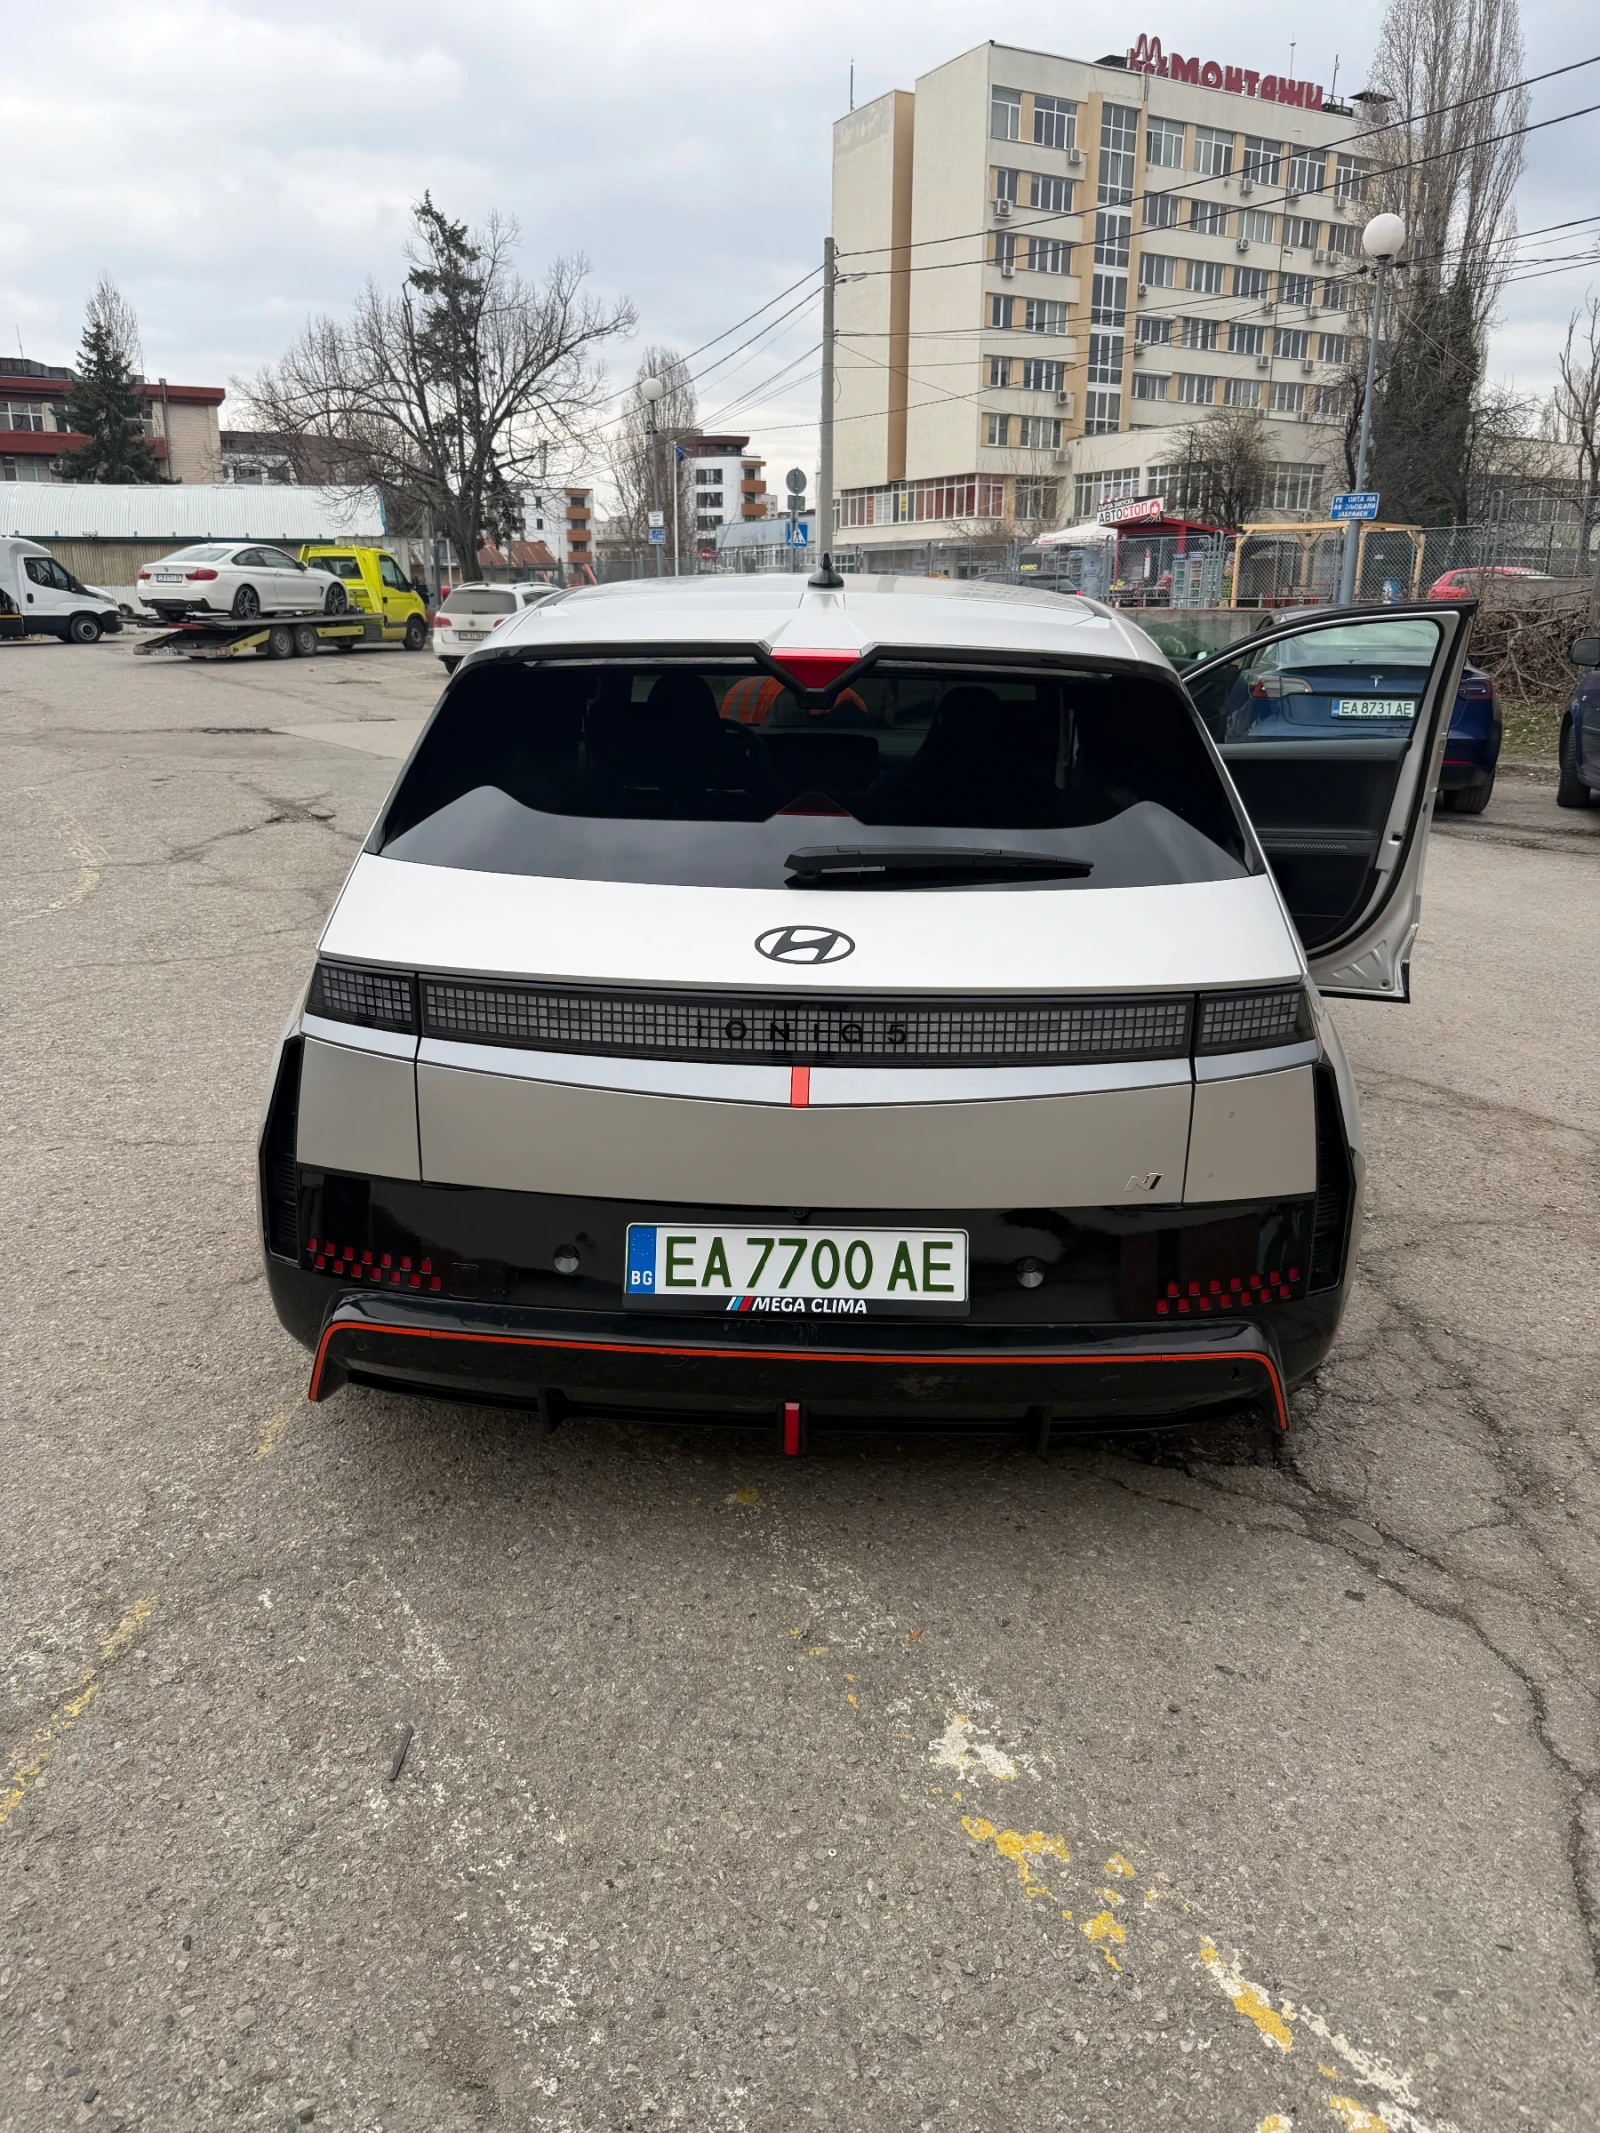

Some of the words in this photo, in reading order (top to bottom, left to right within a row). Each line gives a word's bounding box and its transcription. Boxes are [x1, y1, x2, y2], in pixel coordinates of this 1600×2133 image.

[1169, 52, 1323, 112] МОНТАЖИ
[1335, 496, 1364, 504] РЕОНТА
[1099, 502, 1148, 524] АВТОСТОП
[1341, 702, 1358, 714] EA
[1361, 702, 1392, 715] 8731
[1395, 702, 1412, 715] AE
[665, 1236, 732, 1288] EA
[746, 1237, 873, 1290] 7700
[887, 1240, 955, 1293] AE
[631, 1270, 653, 1286] BG
[752, 1297, 806, 1312] MEGA
[811, 1298, 867, 1314] CLIMA
